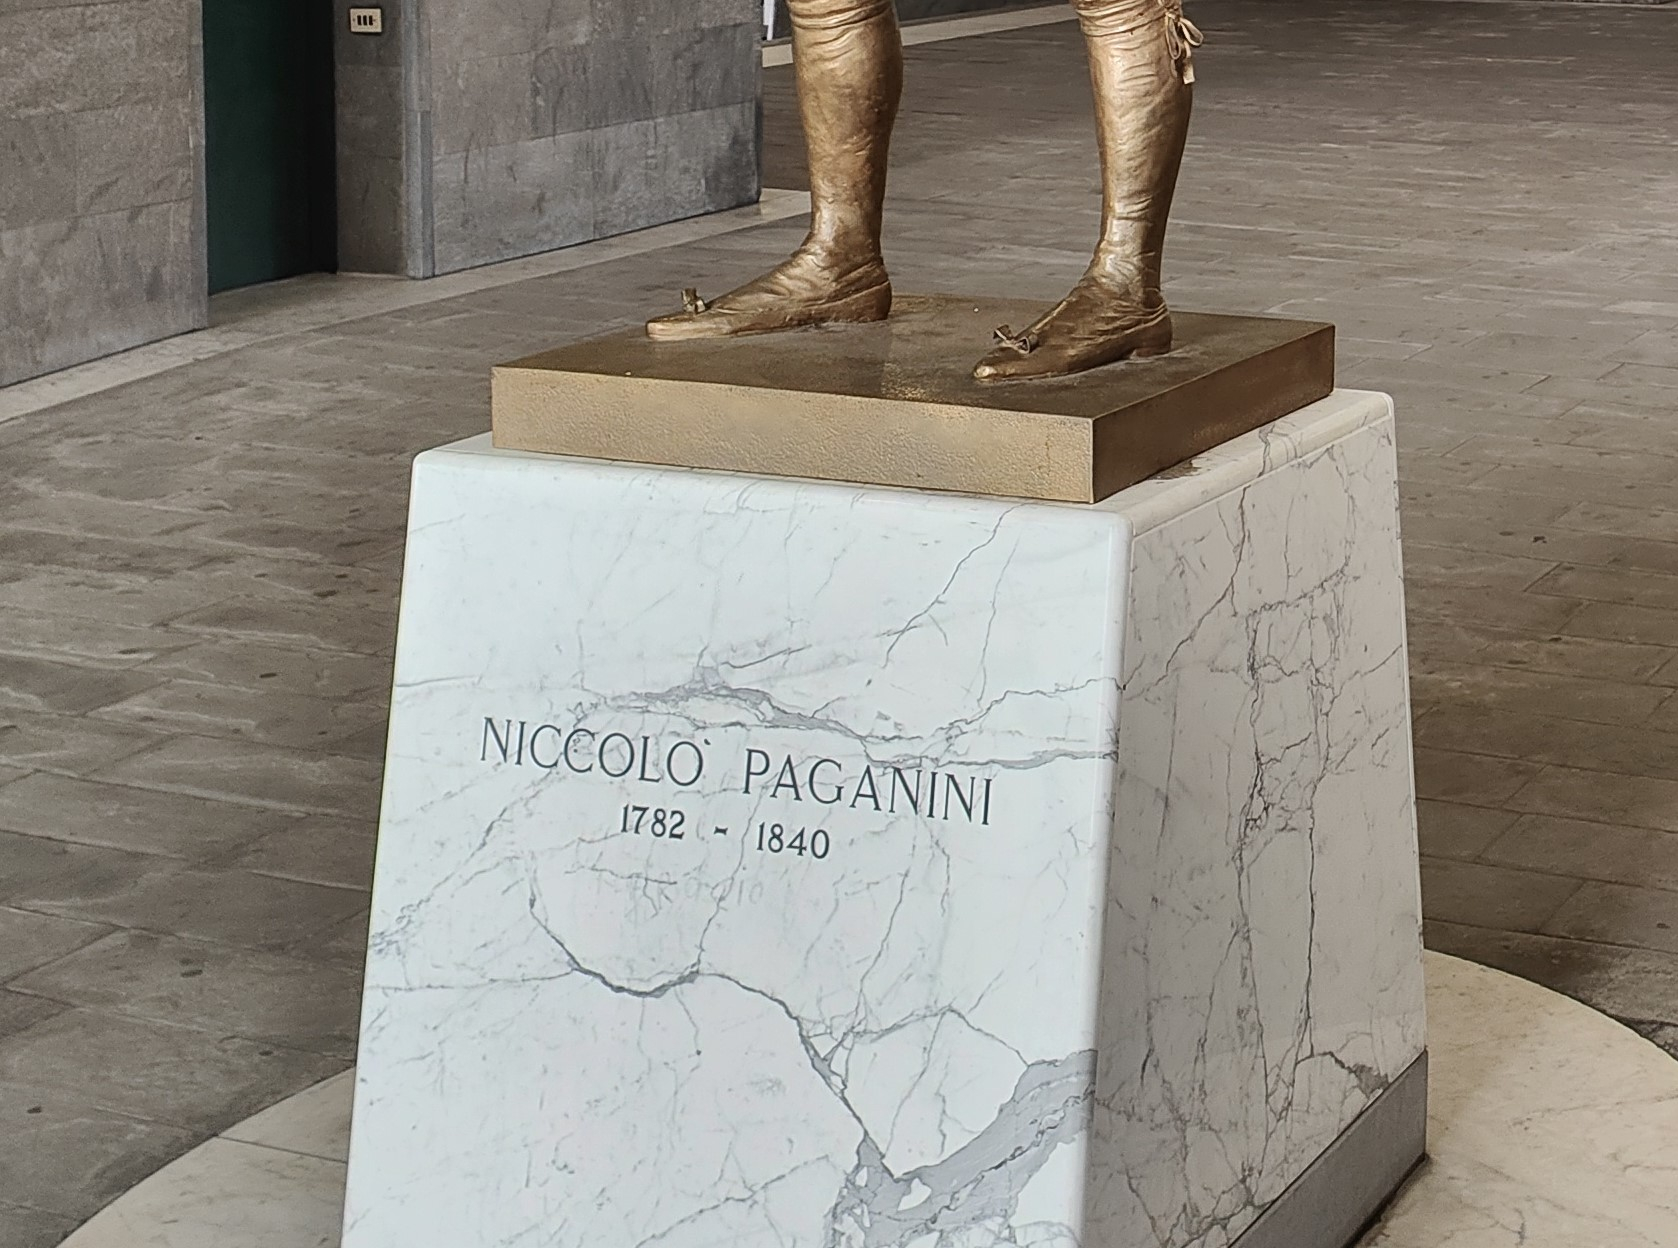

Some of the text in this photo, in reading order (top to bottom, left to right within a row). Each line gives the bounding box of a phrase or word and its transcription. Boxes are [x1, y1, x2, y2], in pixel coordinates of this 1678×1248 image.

[743, 747, 993, 826] PAGANINI
[620, 803, 686, 840] 1782
[756, 822, 831, 860] 1840
